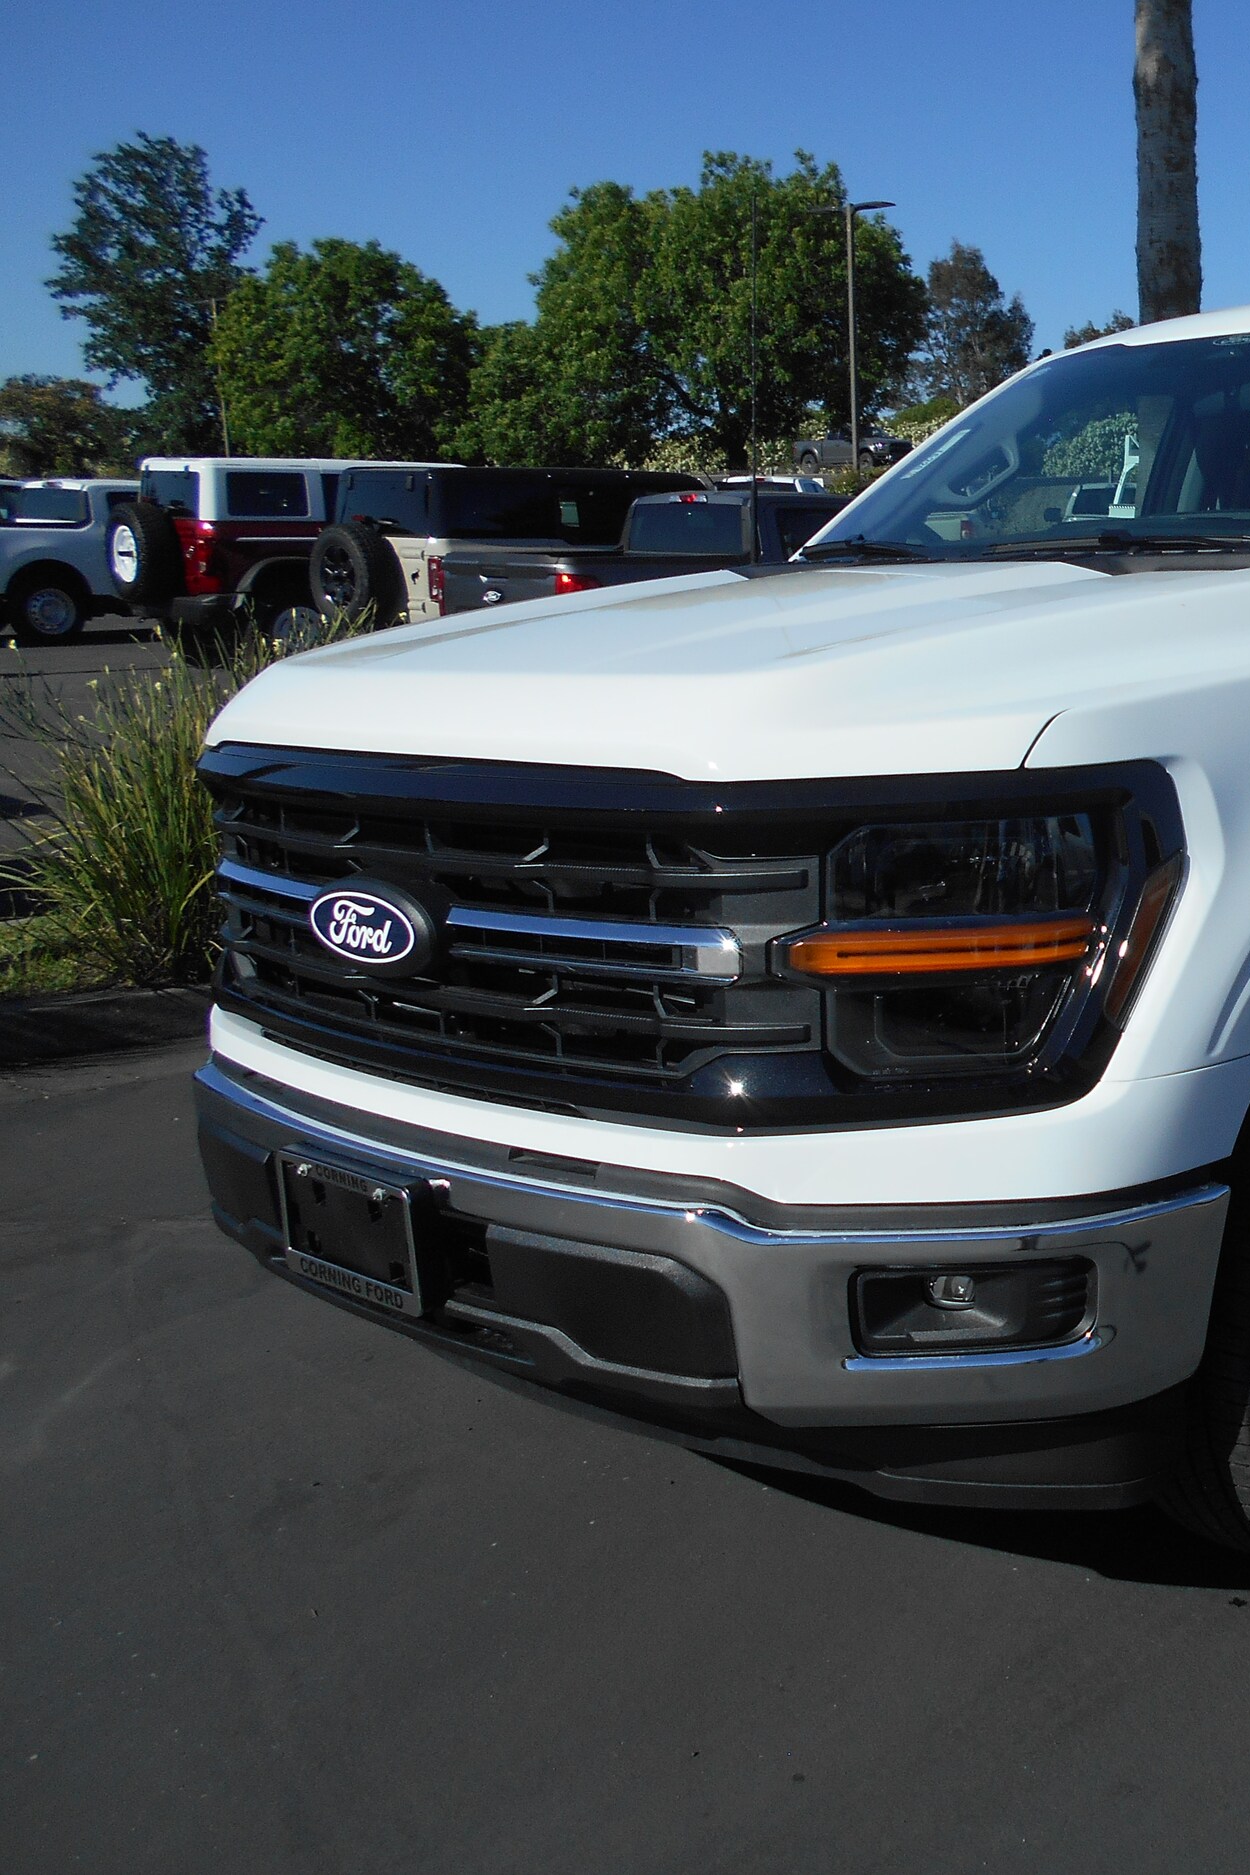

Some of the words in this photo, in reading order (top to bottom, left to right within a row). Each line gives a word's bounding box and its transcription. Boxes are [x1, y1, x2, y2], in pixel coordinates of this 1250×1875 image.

[329, 900, 393, 953] Ford
[315, 1164, 369, 1193] CORNING
[299, 1257, 362, 1293] CORNING
[365, 1280, 404, 1310] FORD
